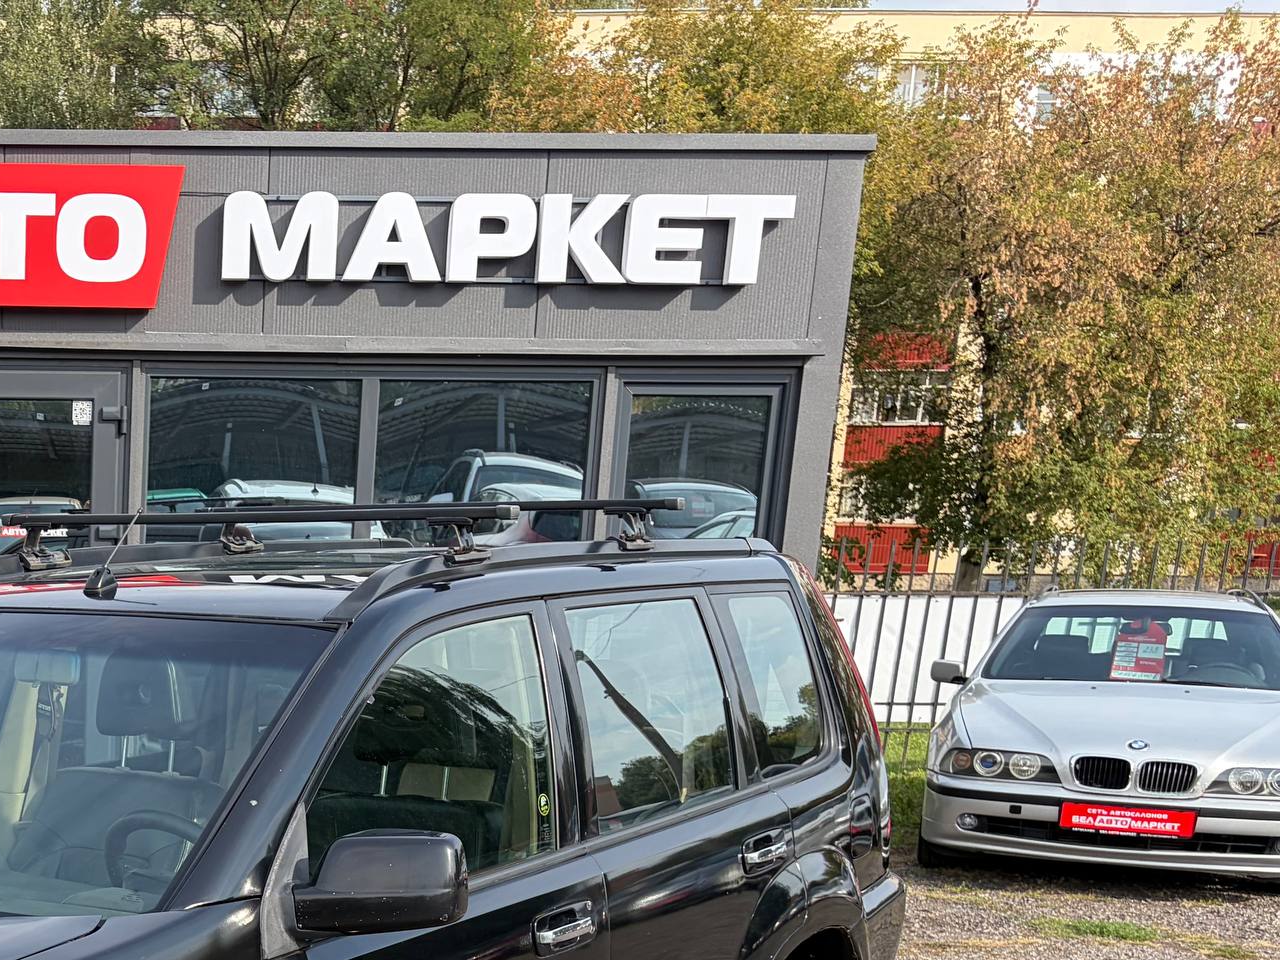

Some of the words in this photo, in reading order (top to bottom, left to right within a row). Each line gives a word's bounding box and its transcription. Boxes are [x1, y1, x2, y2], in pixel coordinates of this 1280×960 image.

[220, 190, 797, 286] МАРКЕТ
[1, 528, 27, 536] АВТО
[1109, 810, 1169, 819] АВТОСАЛОНОВ
[1071, 815, 1095, 825] БЕЛ
[1097, 817, 1128, 827] АВТО
[1130, 820, 1181, 831] МАРКЕТ
